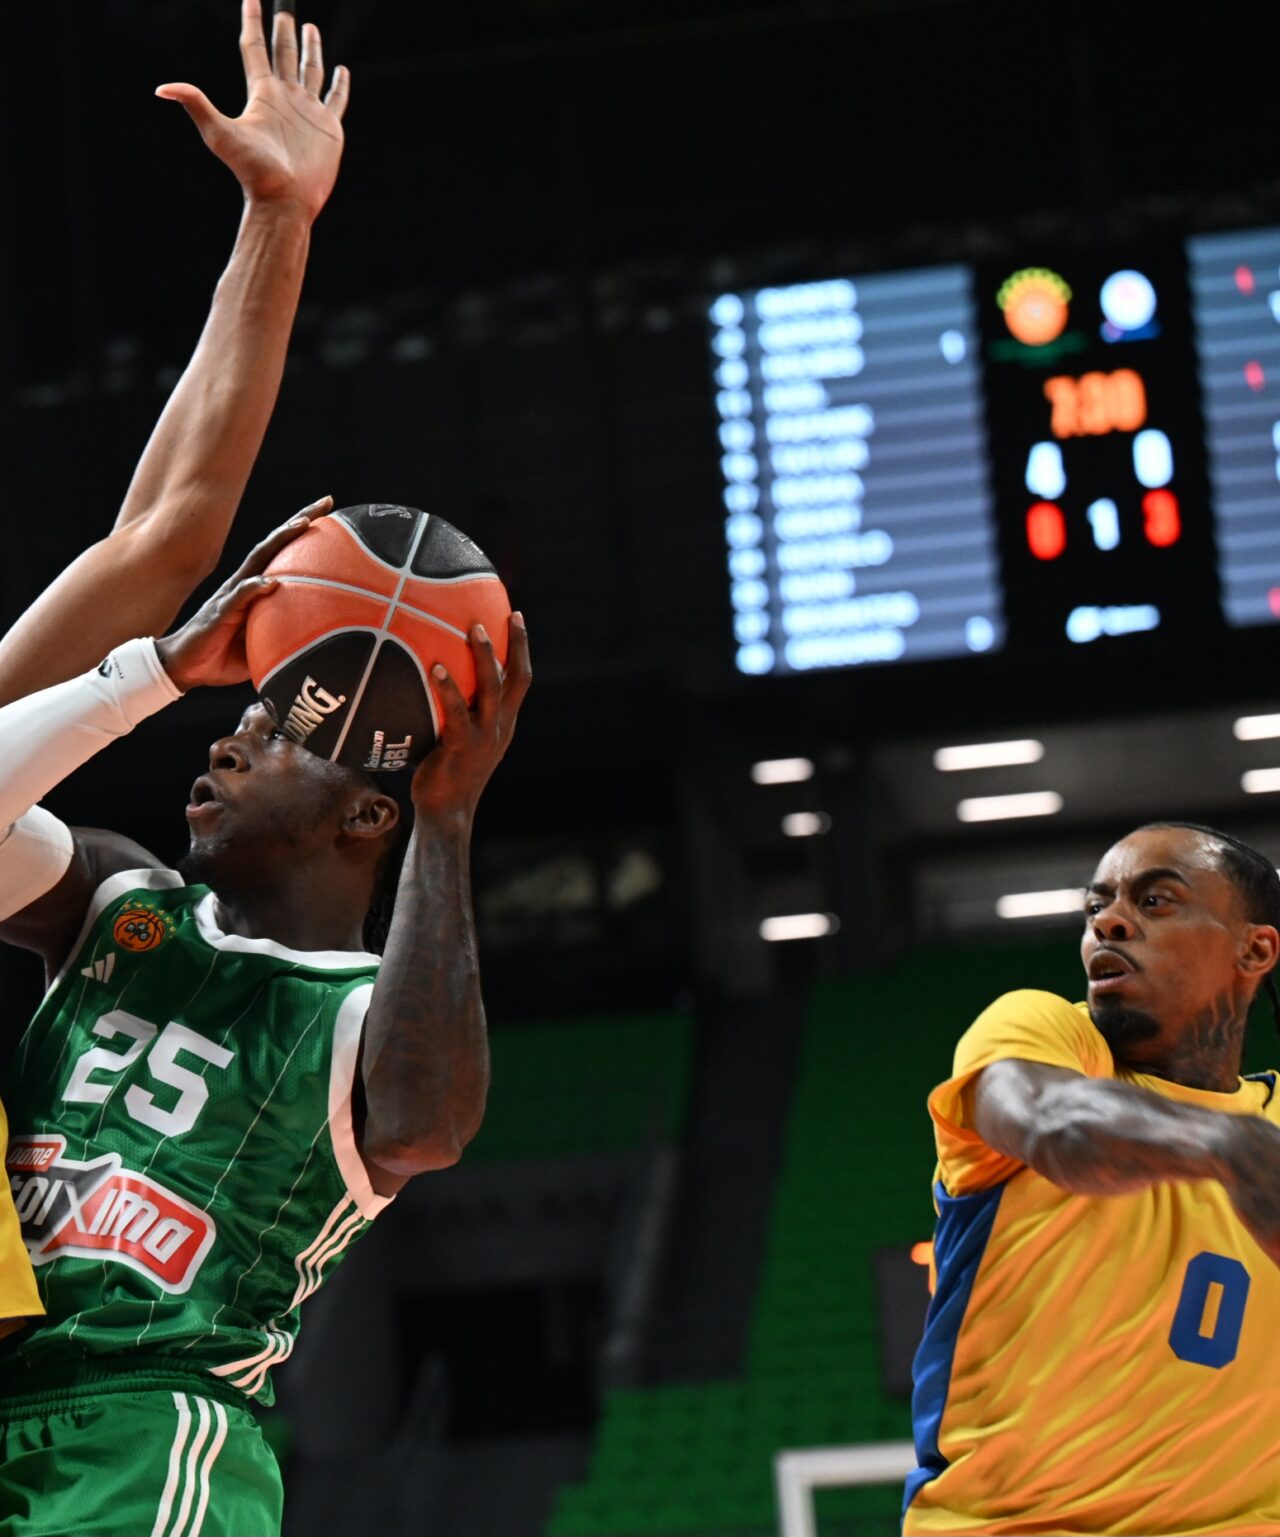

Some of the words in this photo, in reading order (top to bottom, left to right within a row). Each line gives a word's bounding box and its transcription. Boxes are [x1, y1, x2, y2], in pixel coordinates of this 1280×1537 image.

[381, 735, 412, 770] GBL
[61, 1009, 236, 1138] 25
[1167, 1250, 1251, 1370] 0
